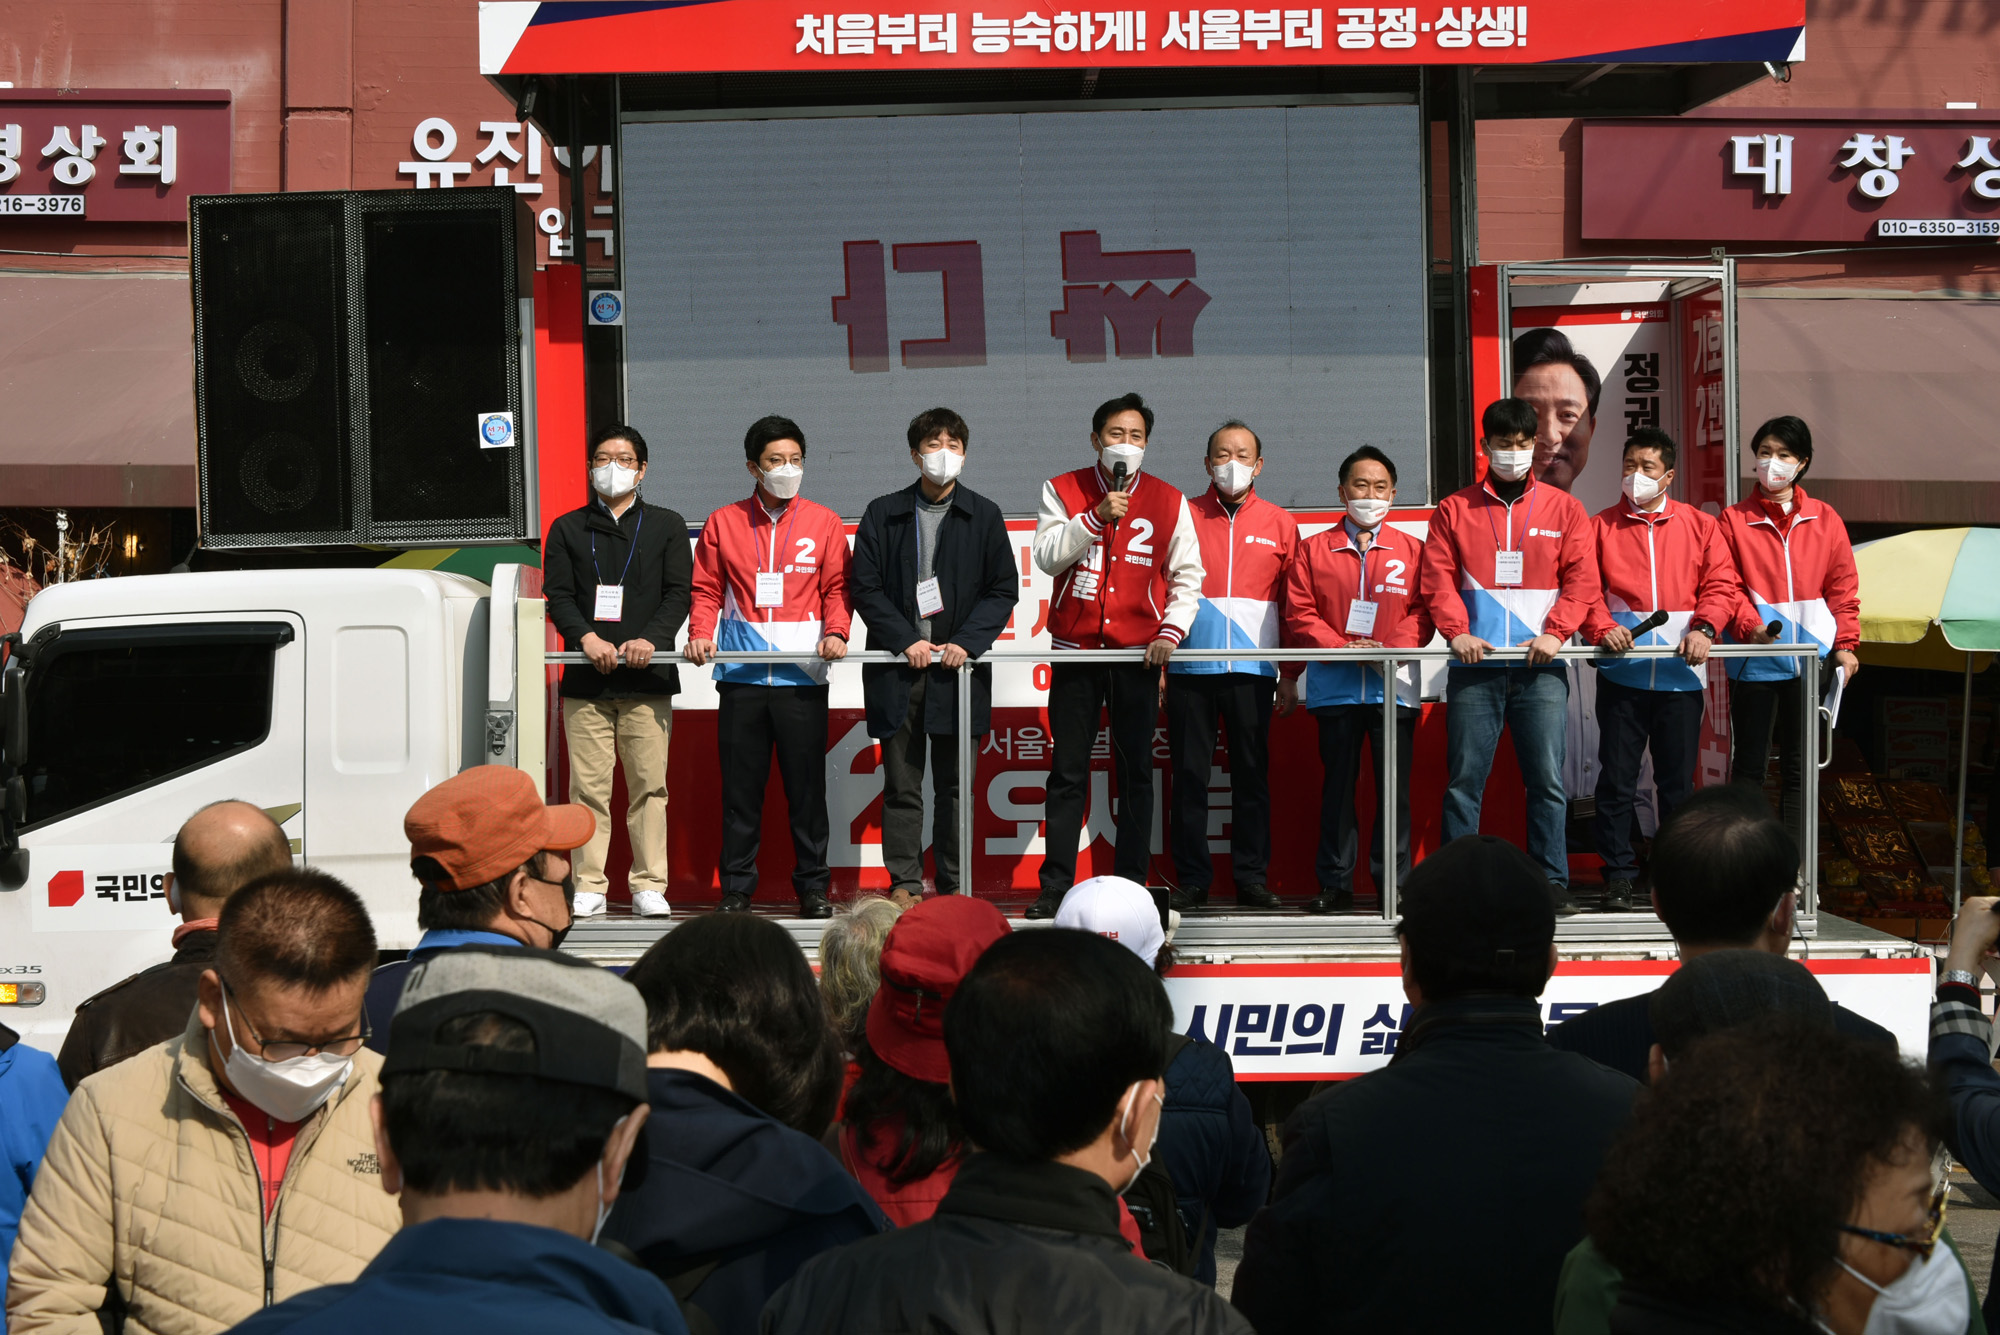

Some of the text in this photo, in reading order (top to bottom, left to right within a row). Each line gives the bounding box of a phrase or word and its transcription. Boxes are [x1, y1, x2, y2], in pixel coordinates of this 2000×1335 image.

[796, 6, 1527, 55] 처음부터 능숙하게! 서울부터 공정·상생!
[0, 197, 81, 212] 16-3976
[1882, 221, 2000, 234] 010-6350-3159
[1634, 309, 1664, 319] 국민의힘
[1127, 517, 1154, 554] 2
[795, 537, 816, 564] 2
[1124, 554, 1153, 567] 국민의힘
[1071, 535, 1104, 602] 세훈
[1385, 559, 1406, 586] 2
[95, 874, 166, 902] 국민의
[1186, 1003, 1346, 1056] 시민의
[347, 1159, 377, 1167] NORTH
[359, 1153, 377, 1161] THE
[353, 1166, 377, 1175] FACE
